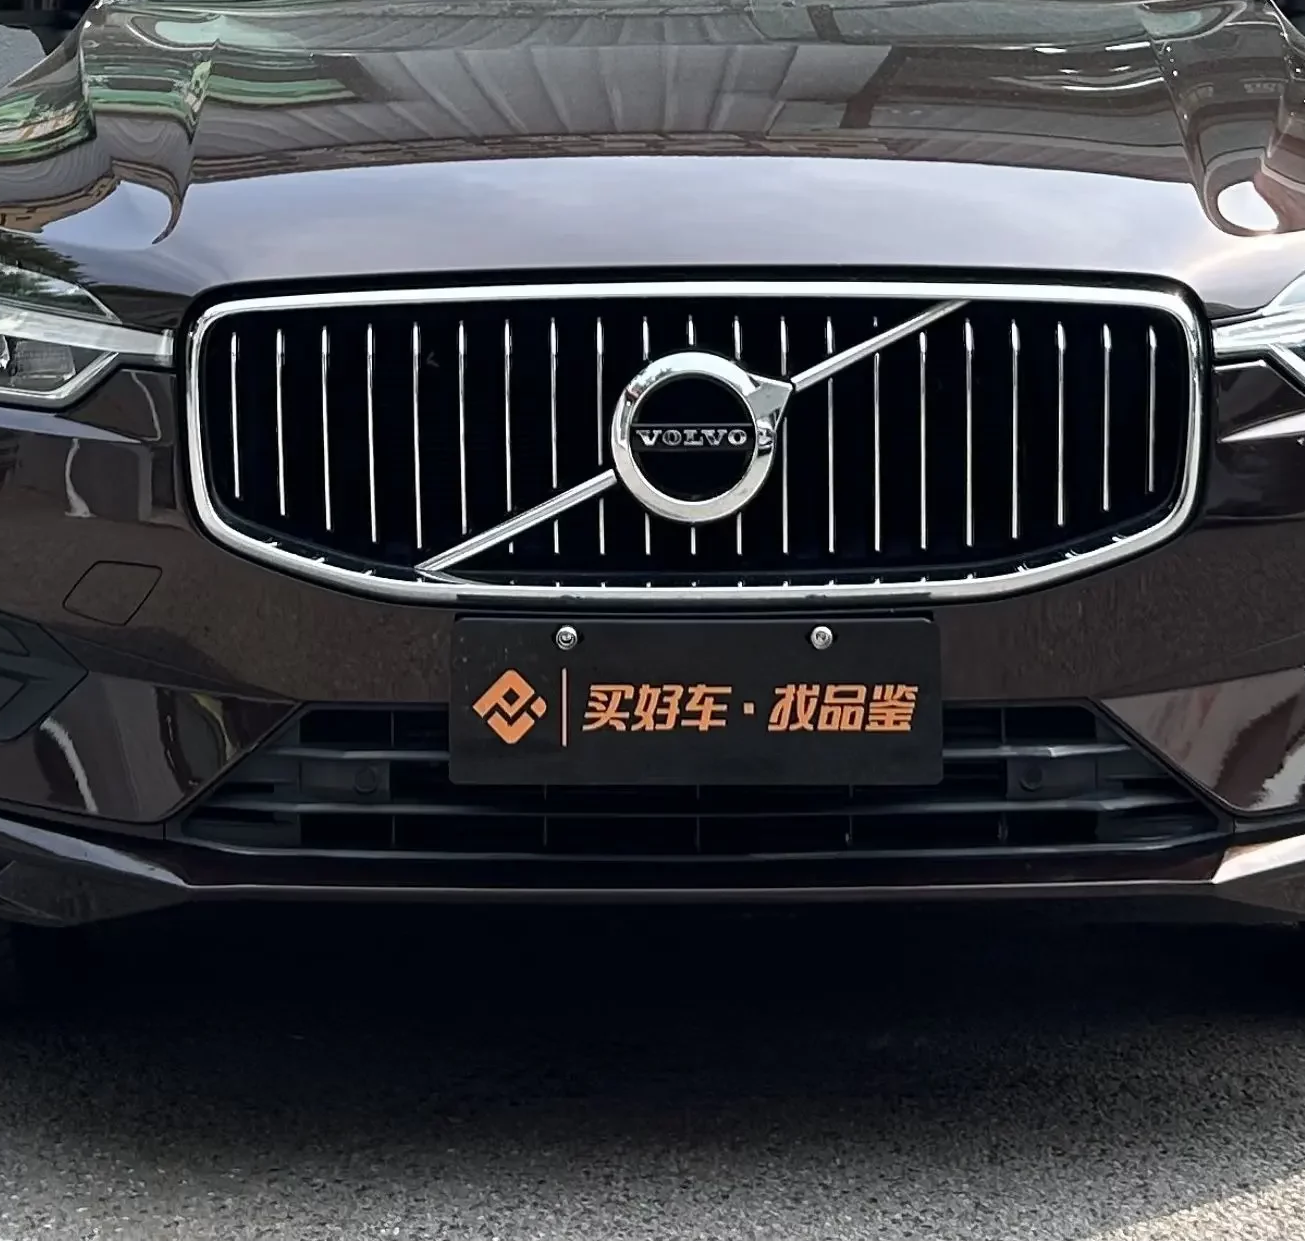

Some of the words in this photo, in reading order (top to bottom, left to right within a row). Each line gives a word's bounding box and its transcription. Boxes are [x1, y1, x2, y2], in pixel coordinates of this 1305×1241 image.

[636, 429, 747, 447] VOLVO
[582, 684, 918, 732] 买好车·找品鉴
